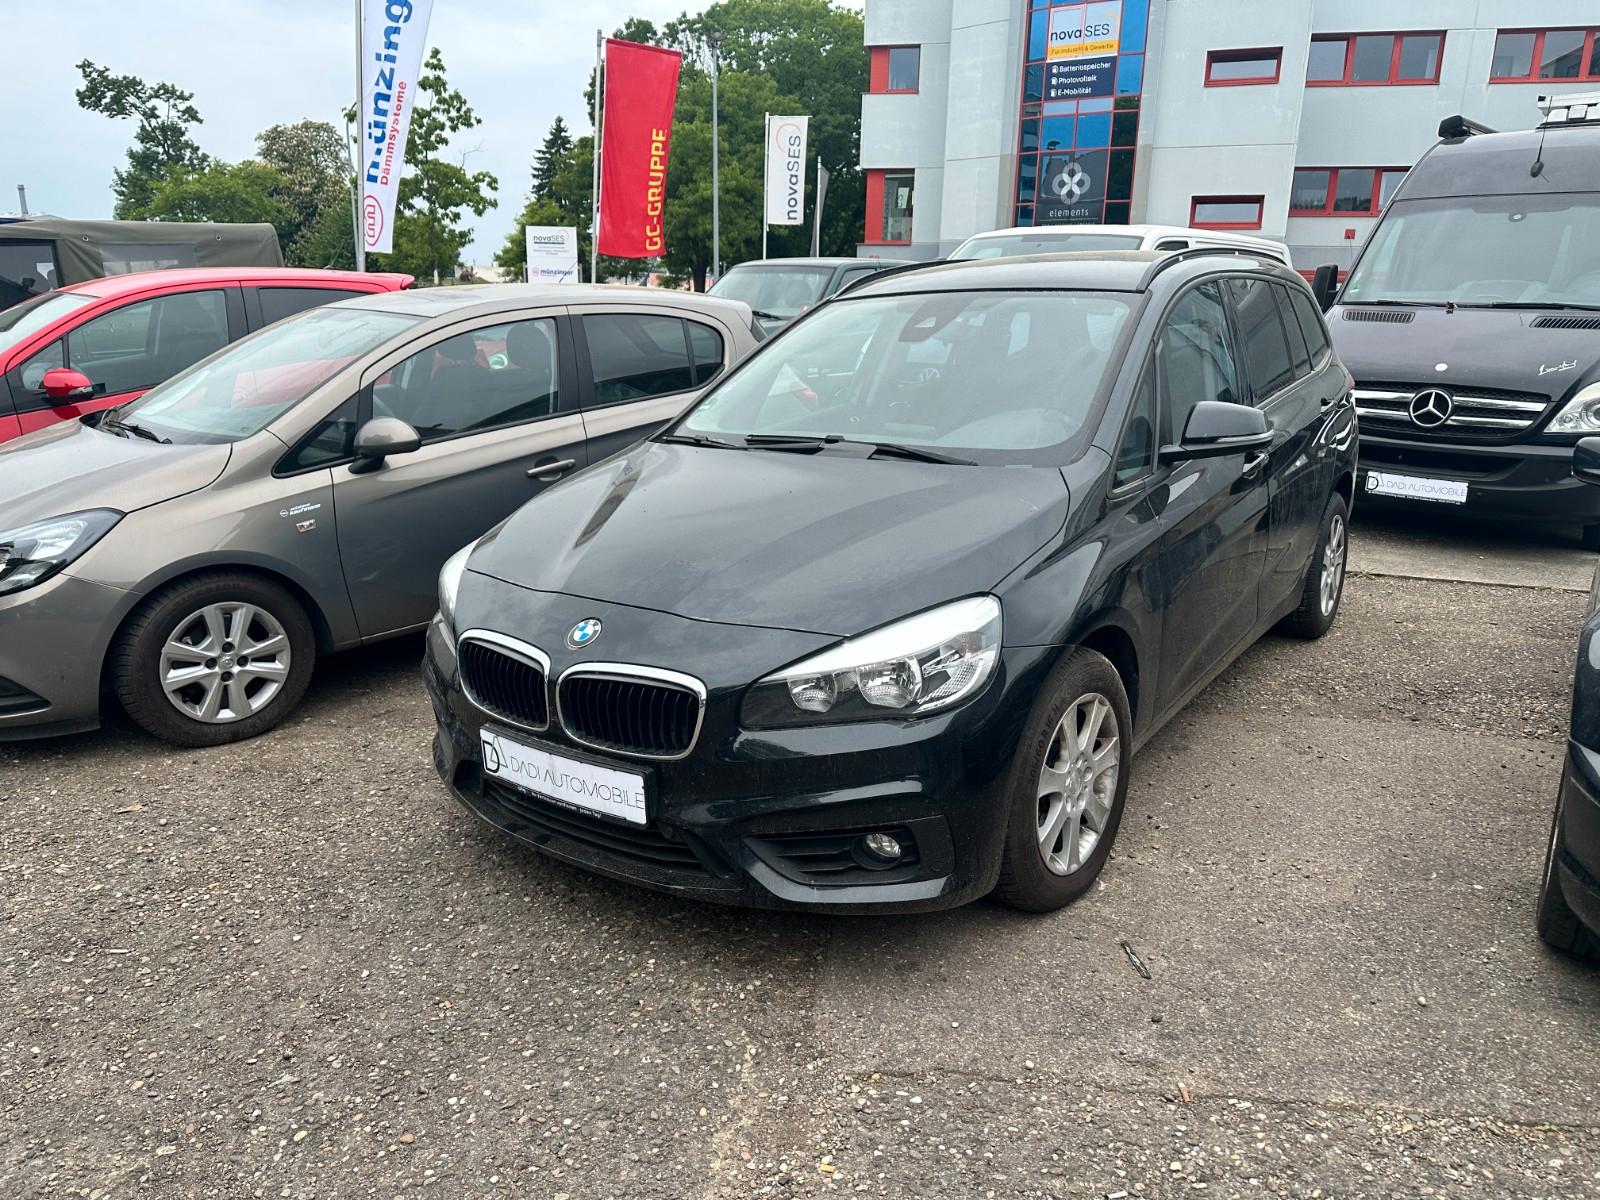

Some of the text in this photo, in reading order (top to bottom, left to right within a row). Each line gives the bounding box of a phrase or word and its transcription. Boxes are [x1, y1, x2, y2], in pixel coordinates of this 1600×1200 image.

[786, 135, 801, 220] novaSES
[1049, 208, 1089, 217] elements
[510, 756, 540, 781] DADI
[543, 768, 645, 810] AUTOMOBILE
